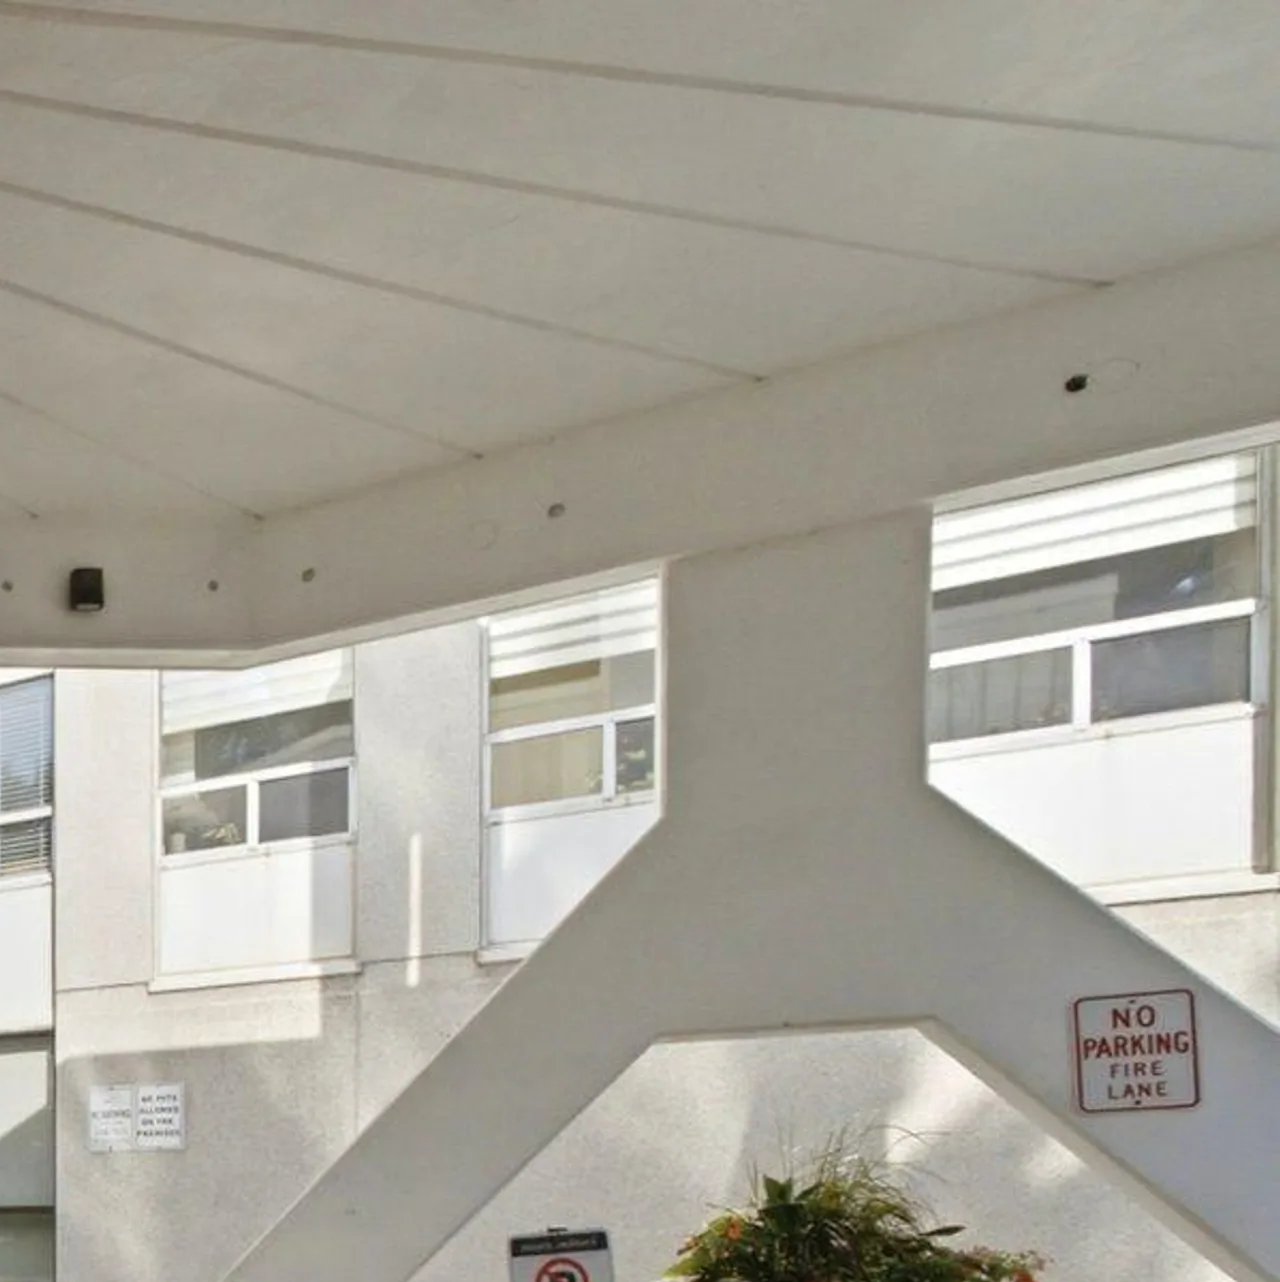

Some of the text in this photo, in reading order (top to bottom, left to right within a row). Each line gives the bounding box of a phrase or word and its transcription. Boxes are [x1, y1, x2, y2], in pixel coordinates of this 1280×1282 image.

[1111, 1005, 1156, 1028] NO
[1083, 1031, 1189, 1060] PARKING
[1109, 1060, 1164, 1079] FIRE
[1107, 1081, 1168, 1100] LANE
